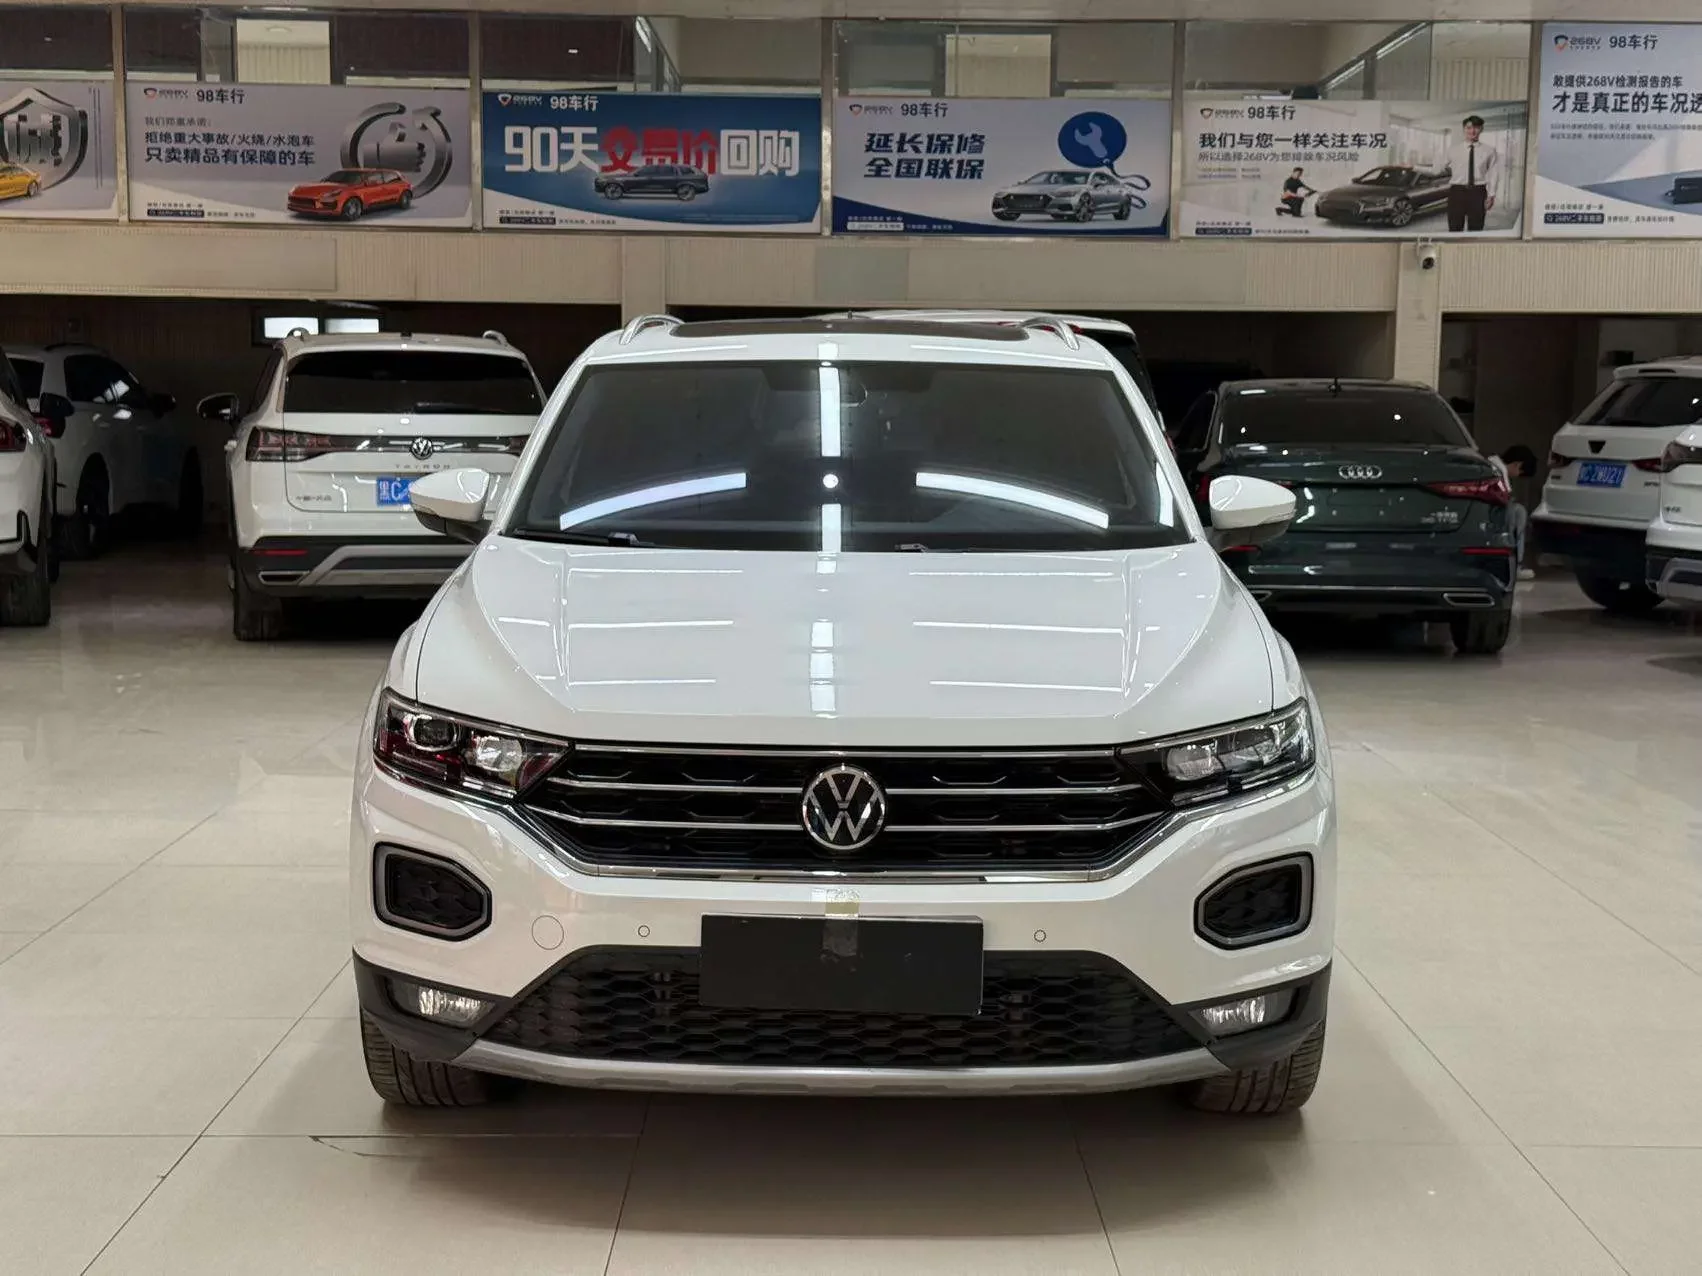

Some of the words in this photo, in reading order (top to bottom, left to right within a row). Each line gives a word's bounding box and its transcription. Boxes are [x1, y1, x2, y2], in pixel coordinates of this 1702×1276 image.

[1608, 34, 1658, 50] 98车行
[1552, 75, 1683, 89] 敢提供268V检测报告的车
[197, 88, 245, 104] 98车行
[550, 95, 599, 111] 98车行
[900, 102, 949, 118] 98车行
[1247, 104, 1296, 121] 98车行
[144, 131, 315, 147] 拒绝重大事故/火烧/水泡车
[864, 132, 986, 154] 延长保修
[1198, 132, 1388, 149] 我们与您一样关注车况
[145, 147, 316, 166] 只卖精品有保障的车
[504, 125, 801, 178] 90天交易价回购
[1197, 151, 1360, 163] 所以选择268V为您排除车况风险
[863, 157, 985, 180] 全国联保
